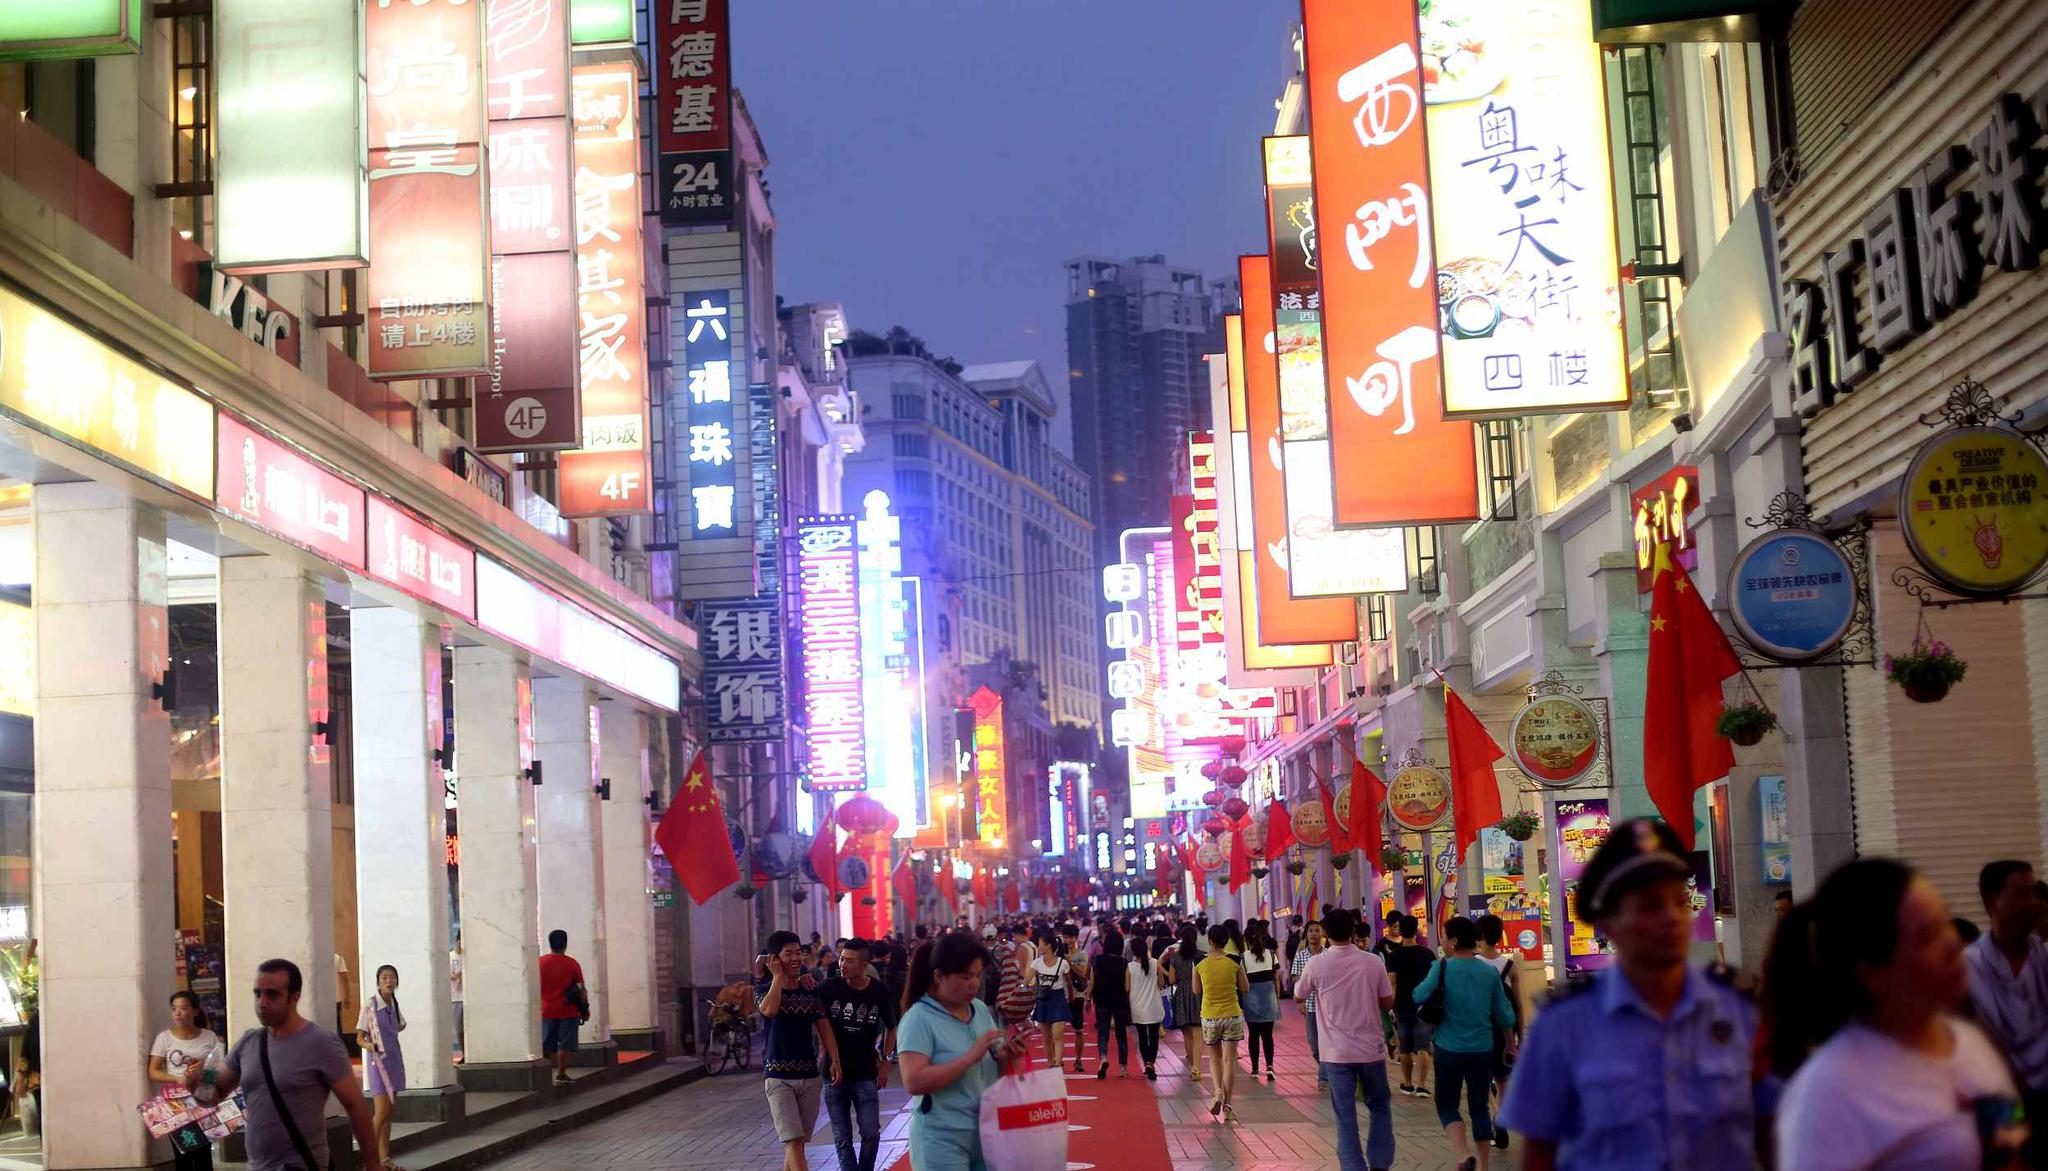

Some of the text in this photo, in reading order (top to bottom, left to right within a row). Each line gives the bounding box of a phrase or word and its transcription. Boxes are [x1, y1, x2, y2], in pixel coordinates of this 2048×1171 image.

[370, 0, 478, 180] 尚皇
[672, 162, 719, 193] 24
[669, 194, 724, 208] 小时营业
[1786, 90, 2048, 417] 名汇国际珠
[210, 272, 291, 354] KFC
[379, 294, 475, 320] 自助烤肉
[381, 321, 475, 349] 请上4楼
[491, 337, 506, 400] Hotpot
[1483, 349, 1589, 391] 四楼
[508, 406, 545, 430] 4F
[583, 423, 638, 445] 肉饭
[1952, 447, 2006, 459] CREATIVE
[1960, 457, 2000, 467] DESIGN
[600, 472, 640, 500] 4F
[710, 609, 777, 725] 银饰
